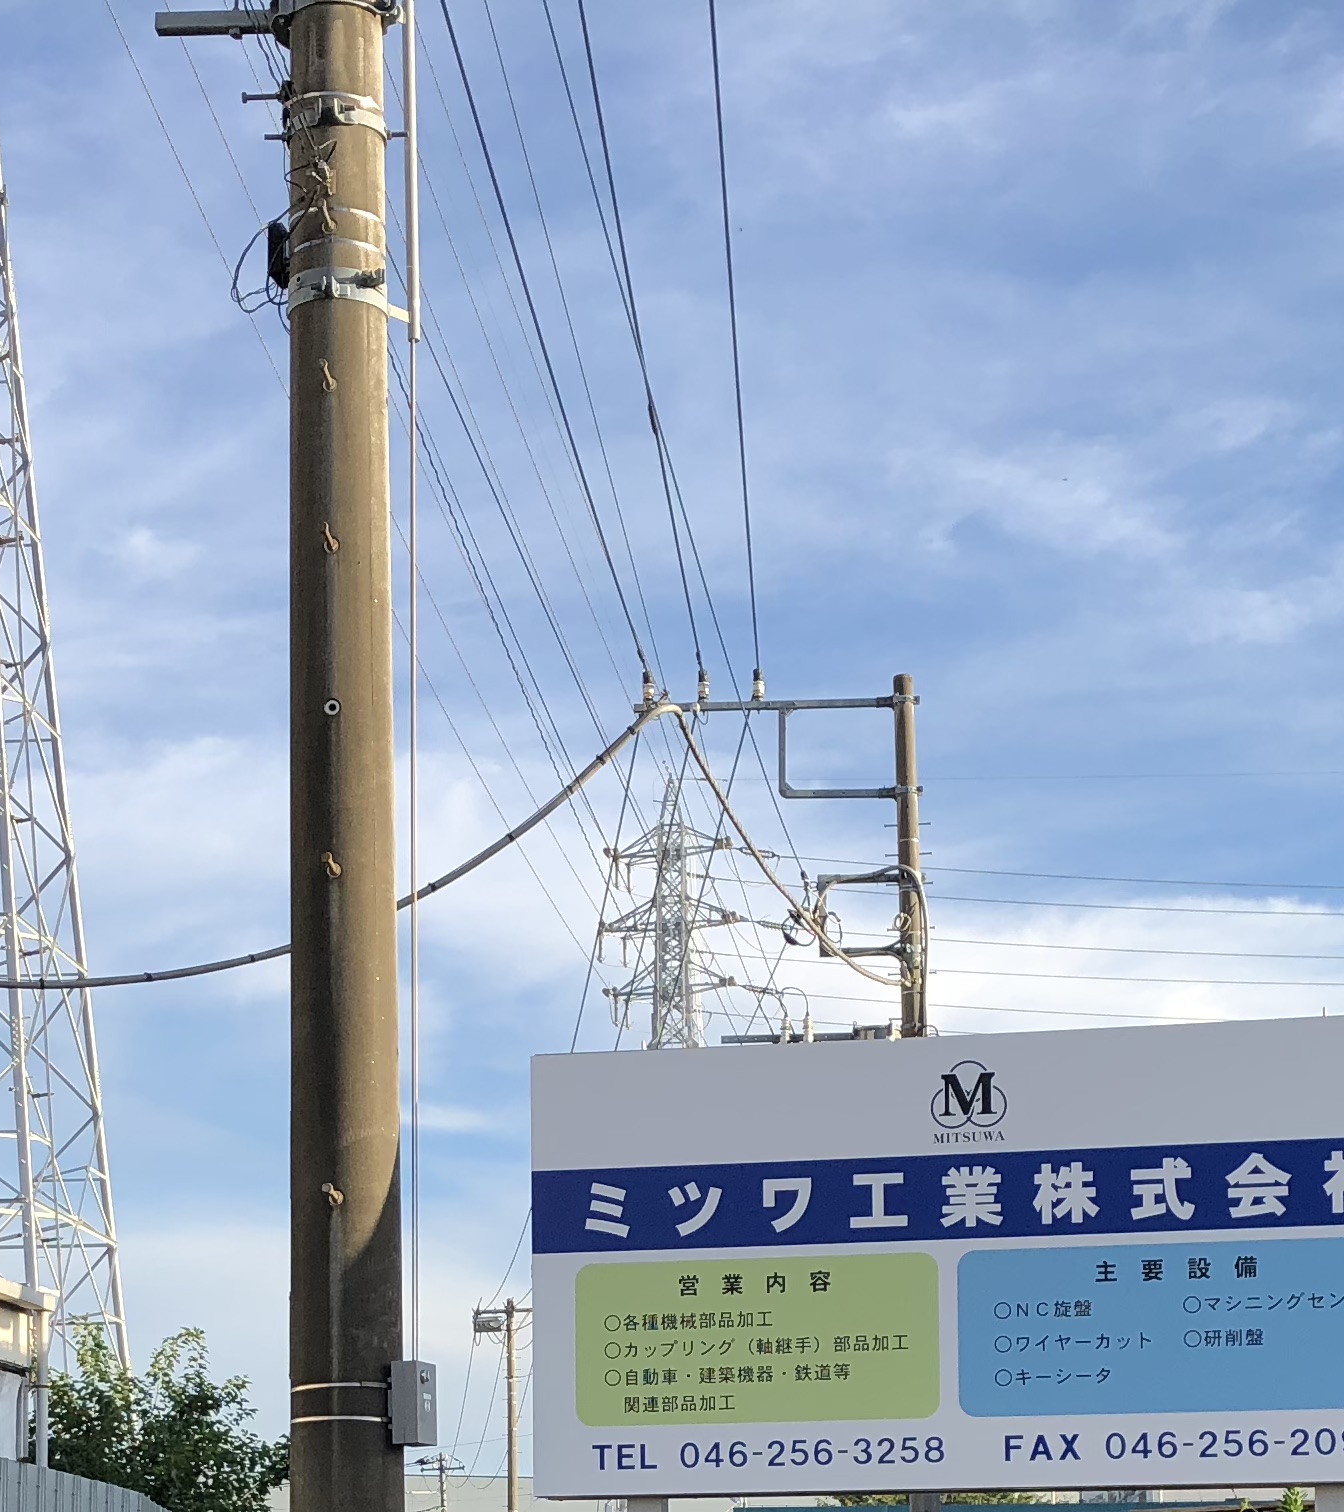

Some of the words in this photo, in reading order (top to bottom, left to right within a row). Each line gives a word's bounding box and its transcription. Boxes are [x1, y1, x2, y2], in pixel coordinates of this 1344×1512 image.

[932, 1130, 1006, 1145] MITSUWA
[1094, 1255, 1259, 1283] 主要設備
[678, 1270, 832, 1297] 営業内容
[623, 1394, 737, 1414] 関連部品加工
[592, 1443, 658, 1471] TEL
[679, 1435, 946, 1469] 046-256-3258
[1003, 1433, 1082, 1462] FAX
